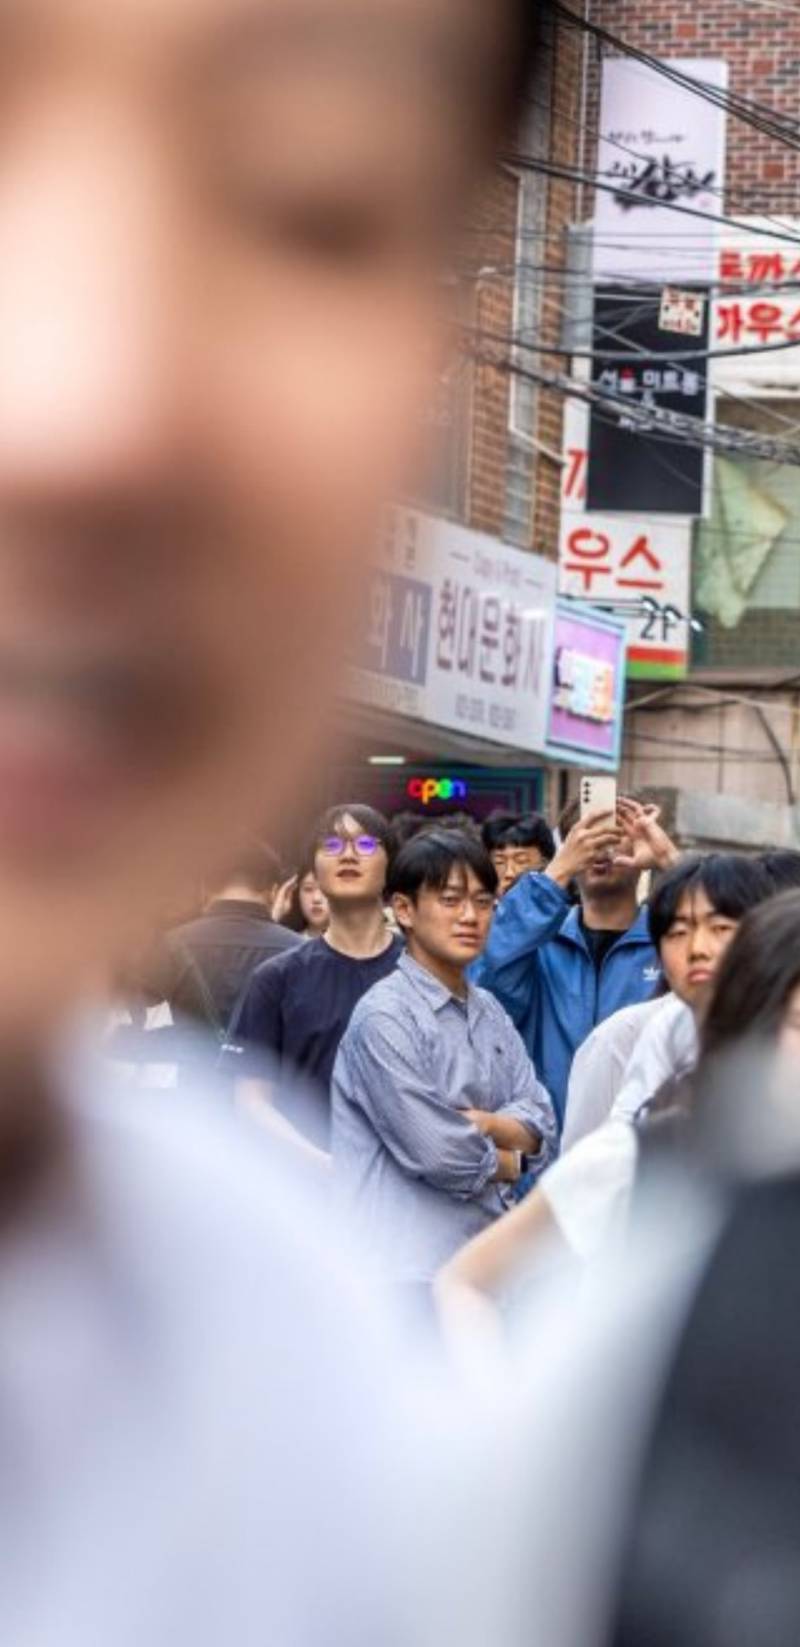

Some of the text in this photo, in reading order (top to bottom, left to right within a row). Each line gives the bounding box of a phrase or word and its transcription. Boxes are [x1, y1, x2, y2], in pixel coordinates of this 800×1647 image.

[565, 529, 663, 591] 우스
[436, 578, 546, 697] 현대문화사
[408, 778, 466, 805] open
